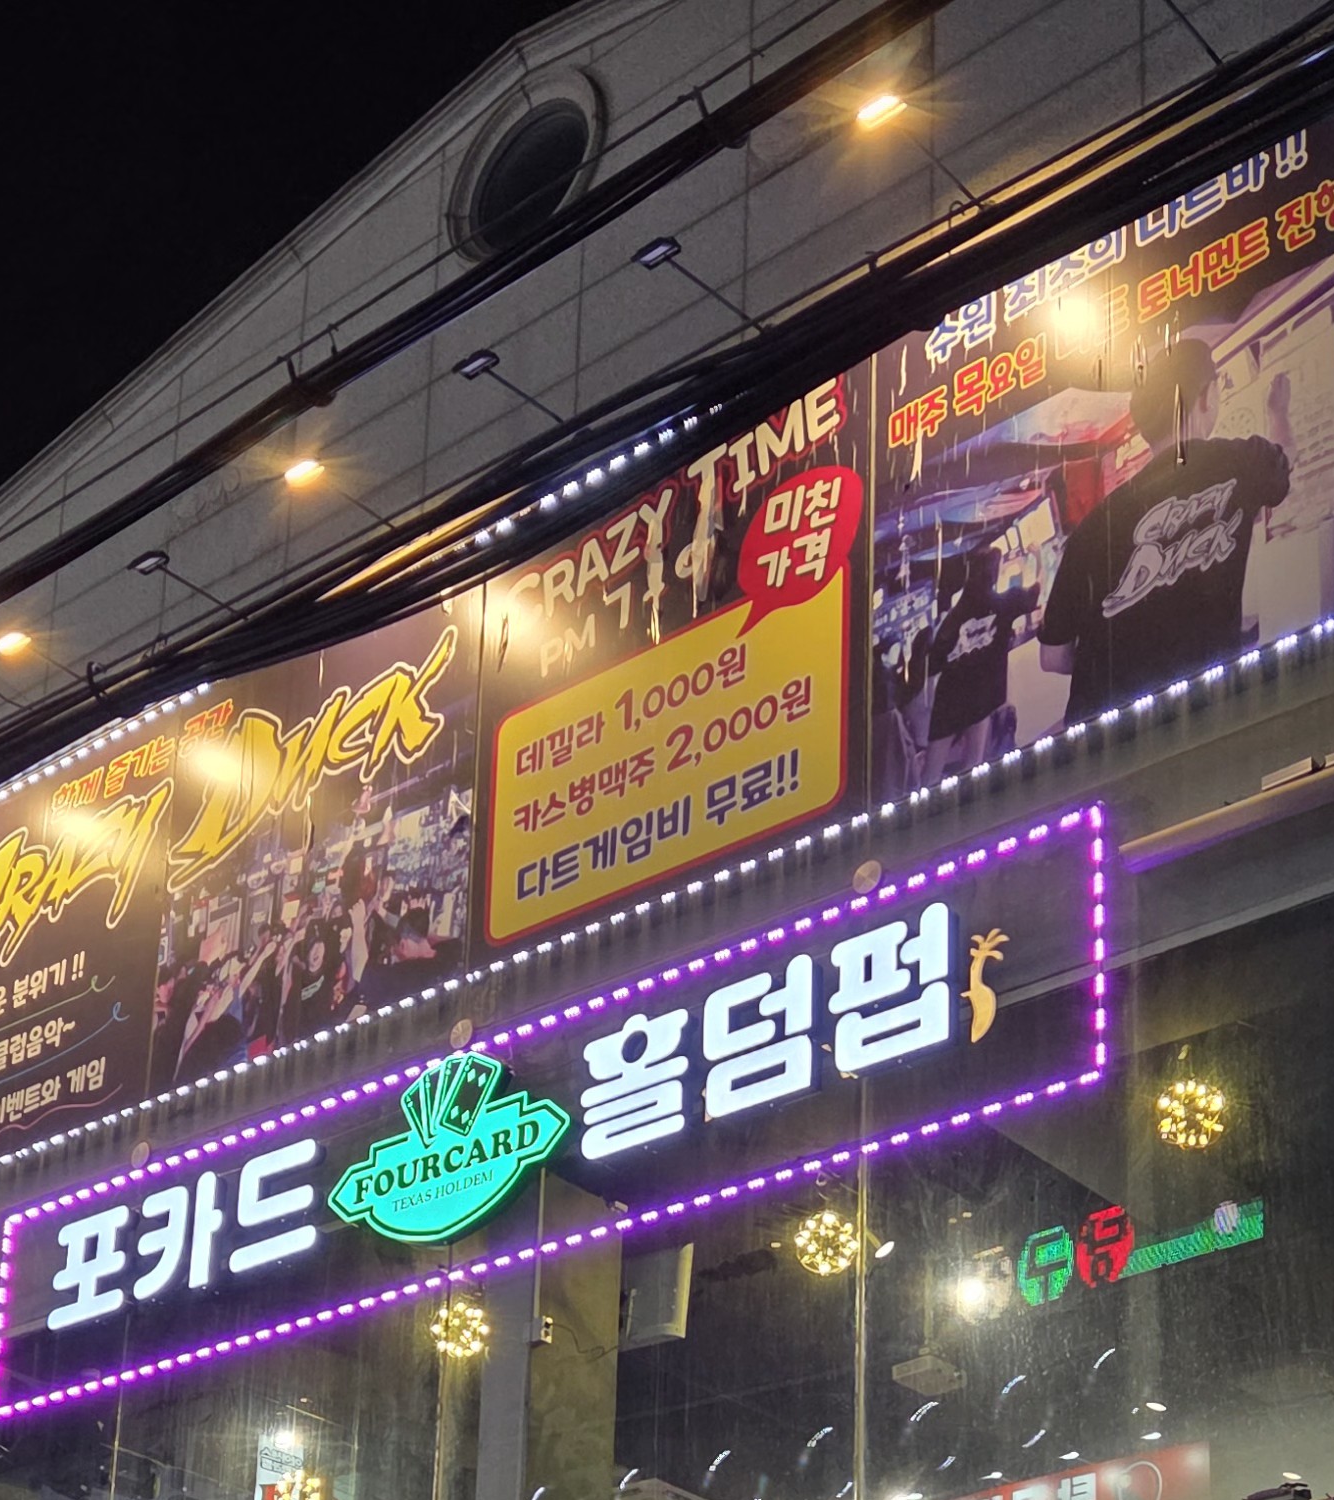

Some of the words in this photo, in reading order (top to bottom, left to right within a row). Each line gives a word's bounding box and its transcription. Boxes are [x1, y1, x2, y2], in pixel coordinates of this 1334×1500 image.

[889, 383, 947, 447] 매주
[953, 334, 1047, 416] 목요일
[1137, 217, 1269, 323] 토너먼트
[508, 488, 673, 620] CRAZY
[687, 378, 839, 493] TIME
[764, 477, 841, 533] 미친
[757, 533, 832, 589] 가격
[540, 612, 596, 678] PM
[167, 625, 458, 890] DUCK
[513, 752, 655, 833] 카스병맥주
[665, 676, 812, 772] 2,000원
[515, 711, 605, 777] 데낄라
[615, 644, 748, 732] 1,000원
[104, 735, 177, 799] 즐기는
[515, 795, 691, 901] 다트게임비
[704, 748, 801, 825] 무료!!
[12, 963, 67, 1010] 분위기
[582, 902, 957, 1160] 홀덤펍
[66, 1057, 106, 1104] 게임
[353, 1118, 540, 1205] FOURCARD
[392, 1185, 438, 1213] TEXAS
[439, 1169, 494, 1201] HOLDEM
[46, 1137, 321, 1331] 포카드
